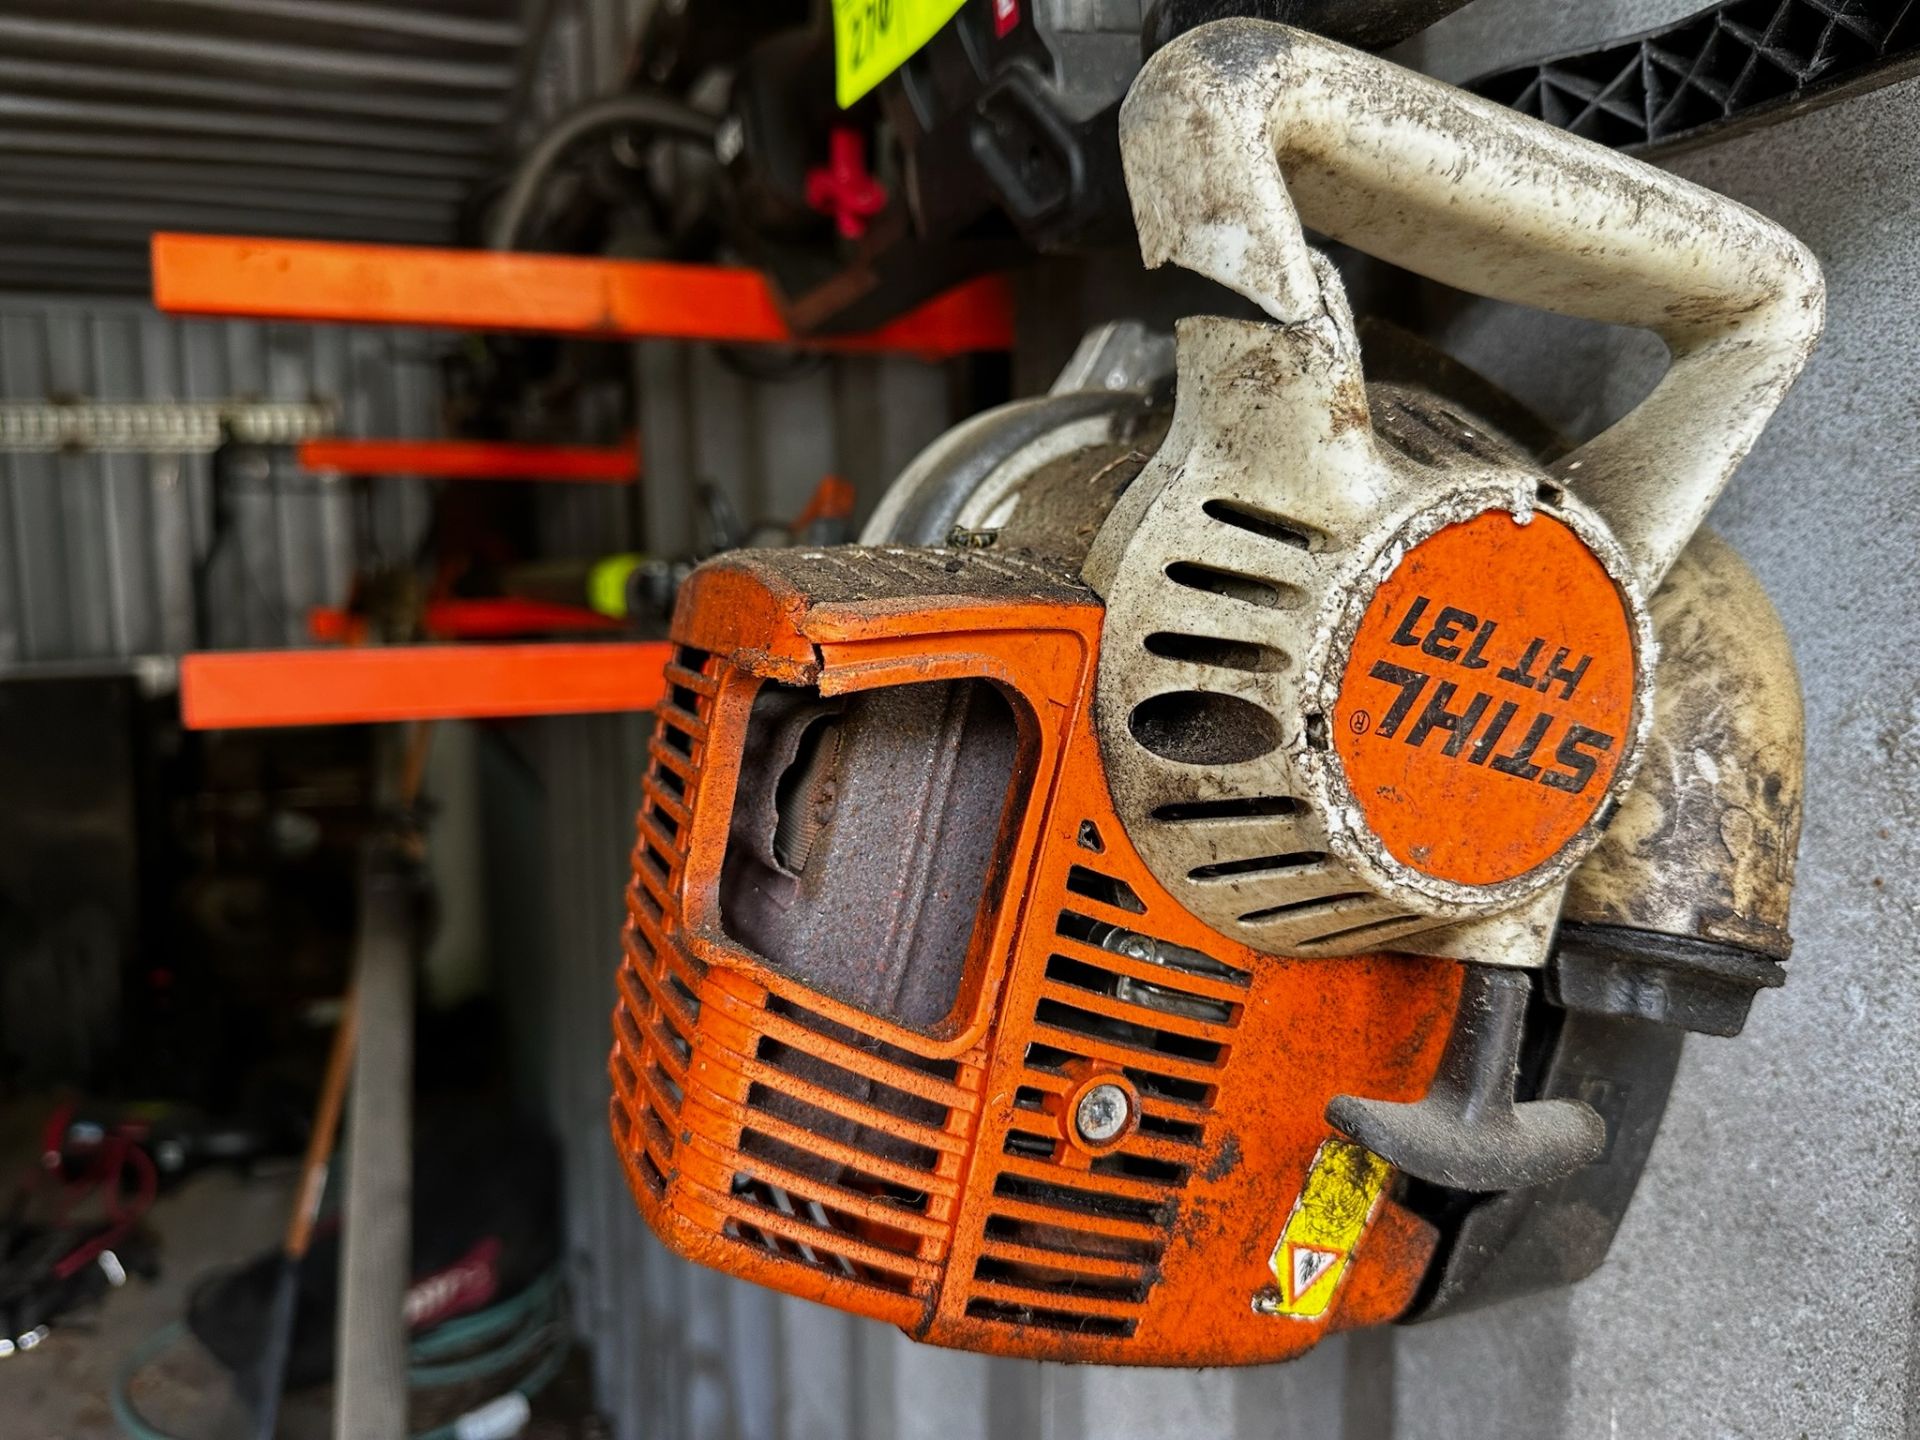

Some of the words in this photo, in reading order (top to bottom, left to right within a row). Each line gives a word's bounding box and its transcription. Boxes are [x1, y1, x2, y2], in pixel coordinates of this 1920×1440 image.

[1391, 596, 1497, 670] 131
[1498, 638, 1592, 700] HT
[1368, 660, 1615, 795] STIHL
